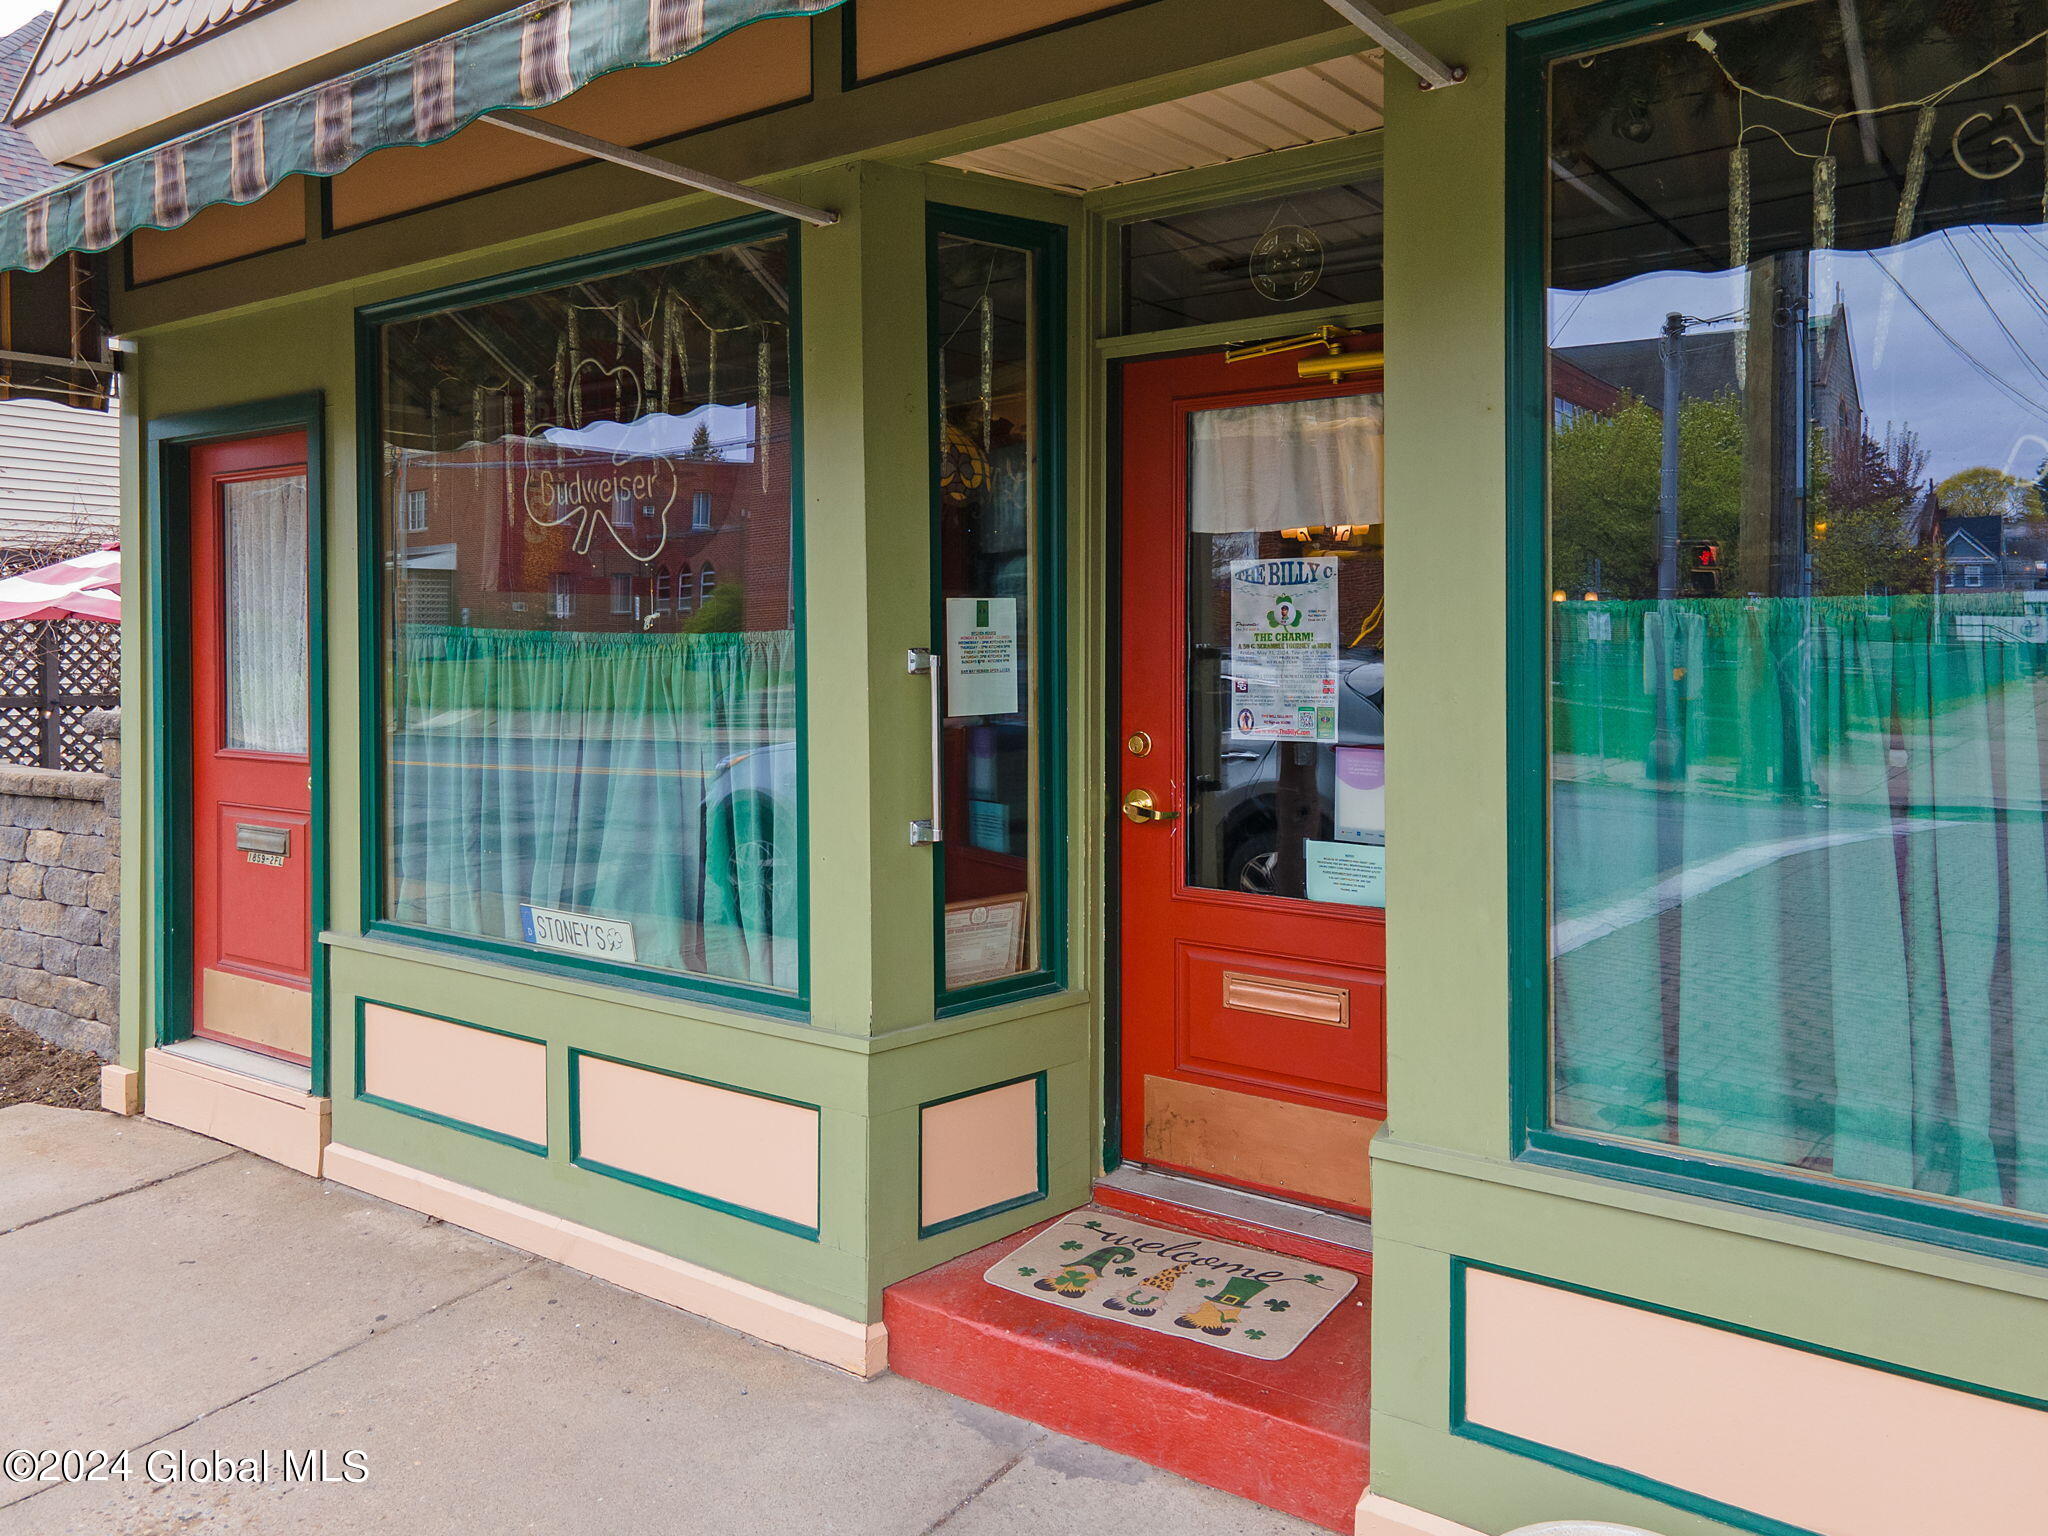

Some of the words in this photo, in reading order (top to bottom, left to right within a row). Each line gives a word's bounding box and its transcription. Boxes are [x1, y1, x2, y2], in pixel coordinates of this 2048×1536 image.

[540, 469, 658, 506] Budweiser
[1235, 564, 1265, 584] THE
[1268, 561, 1320, 585] BILLY
[1254, 633, 1273, 641] THE
[1275, 633, 1314, 641] CHARM!
[536, 915, 606, 950] STONEY'S
[1085, 1226, 1296, 1284] welcome
